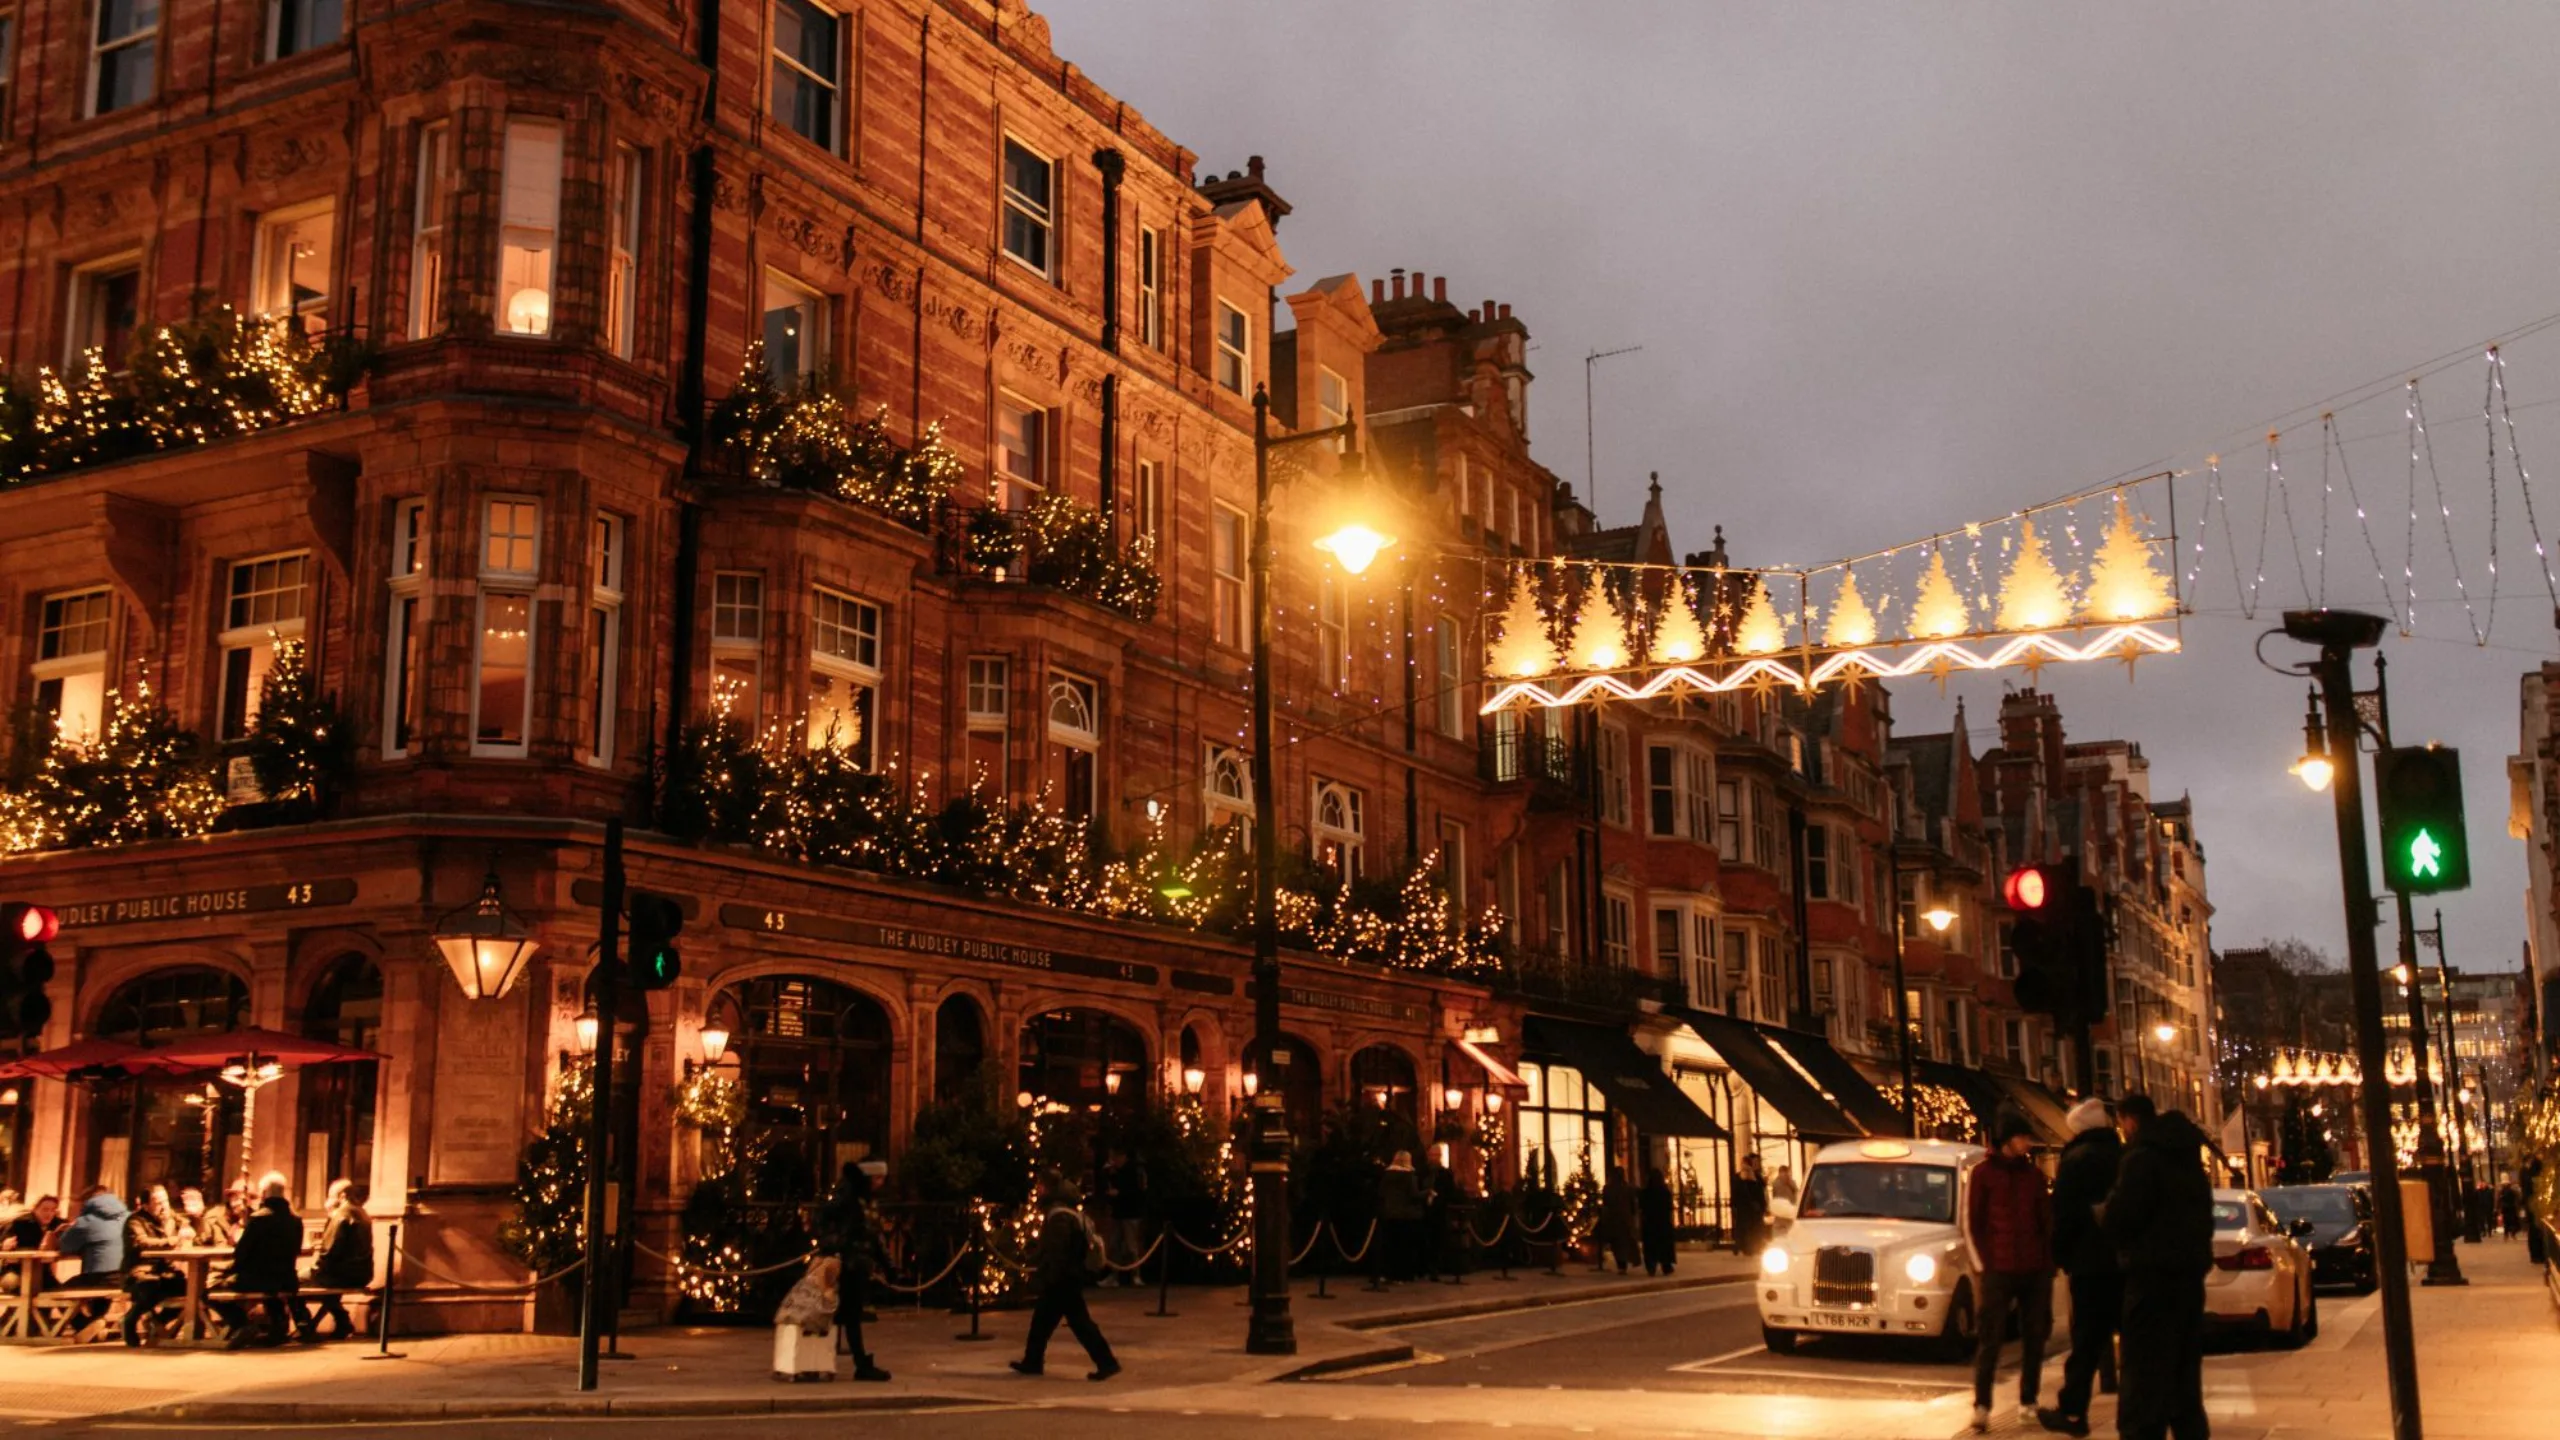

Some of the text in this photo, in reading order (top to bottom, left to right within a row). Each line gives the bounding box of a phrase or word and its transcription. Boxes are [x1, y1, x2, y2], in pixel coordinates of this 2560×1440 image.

[58, 884, 312, 925] UDLEY PUBLIC HOUSE 43
[764, 911, 786, 931] 43
[880, 928, 904, 947] THE
[909, 934, 959, 955] AUDLEY
[963, 940, 1007, 961] PUBLIC
[1012, 950, 1050, 968] HOUSE
